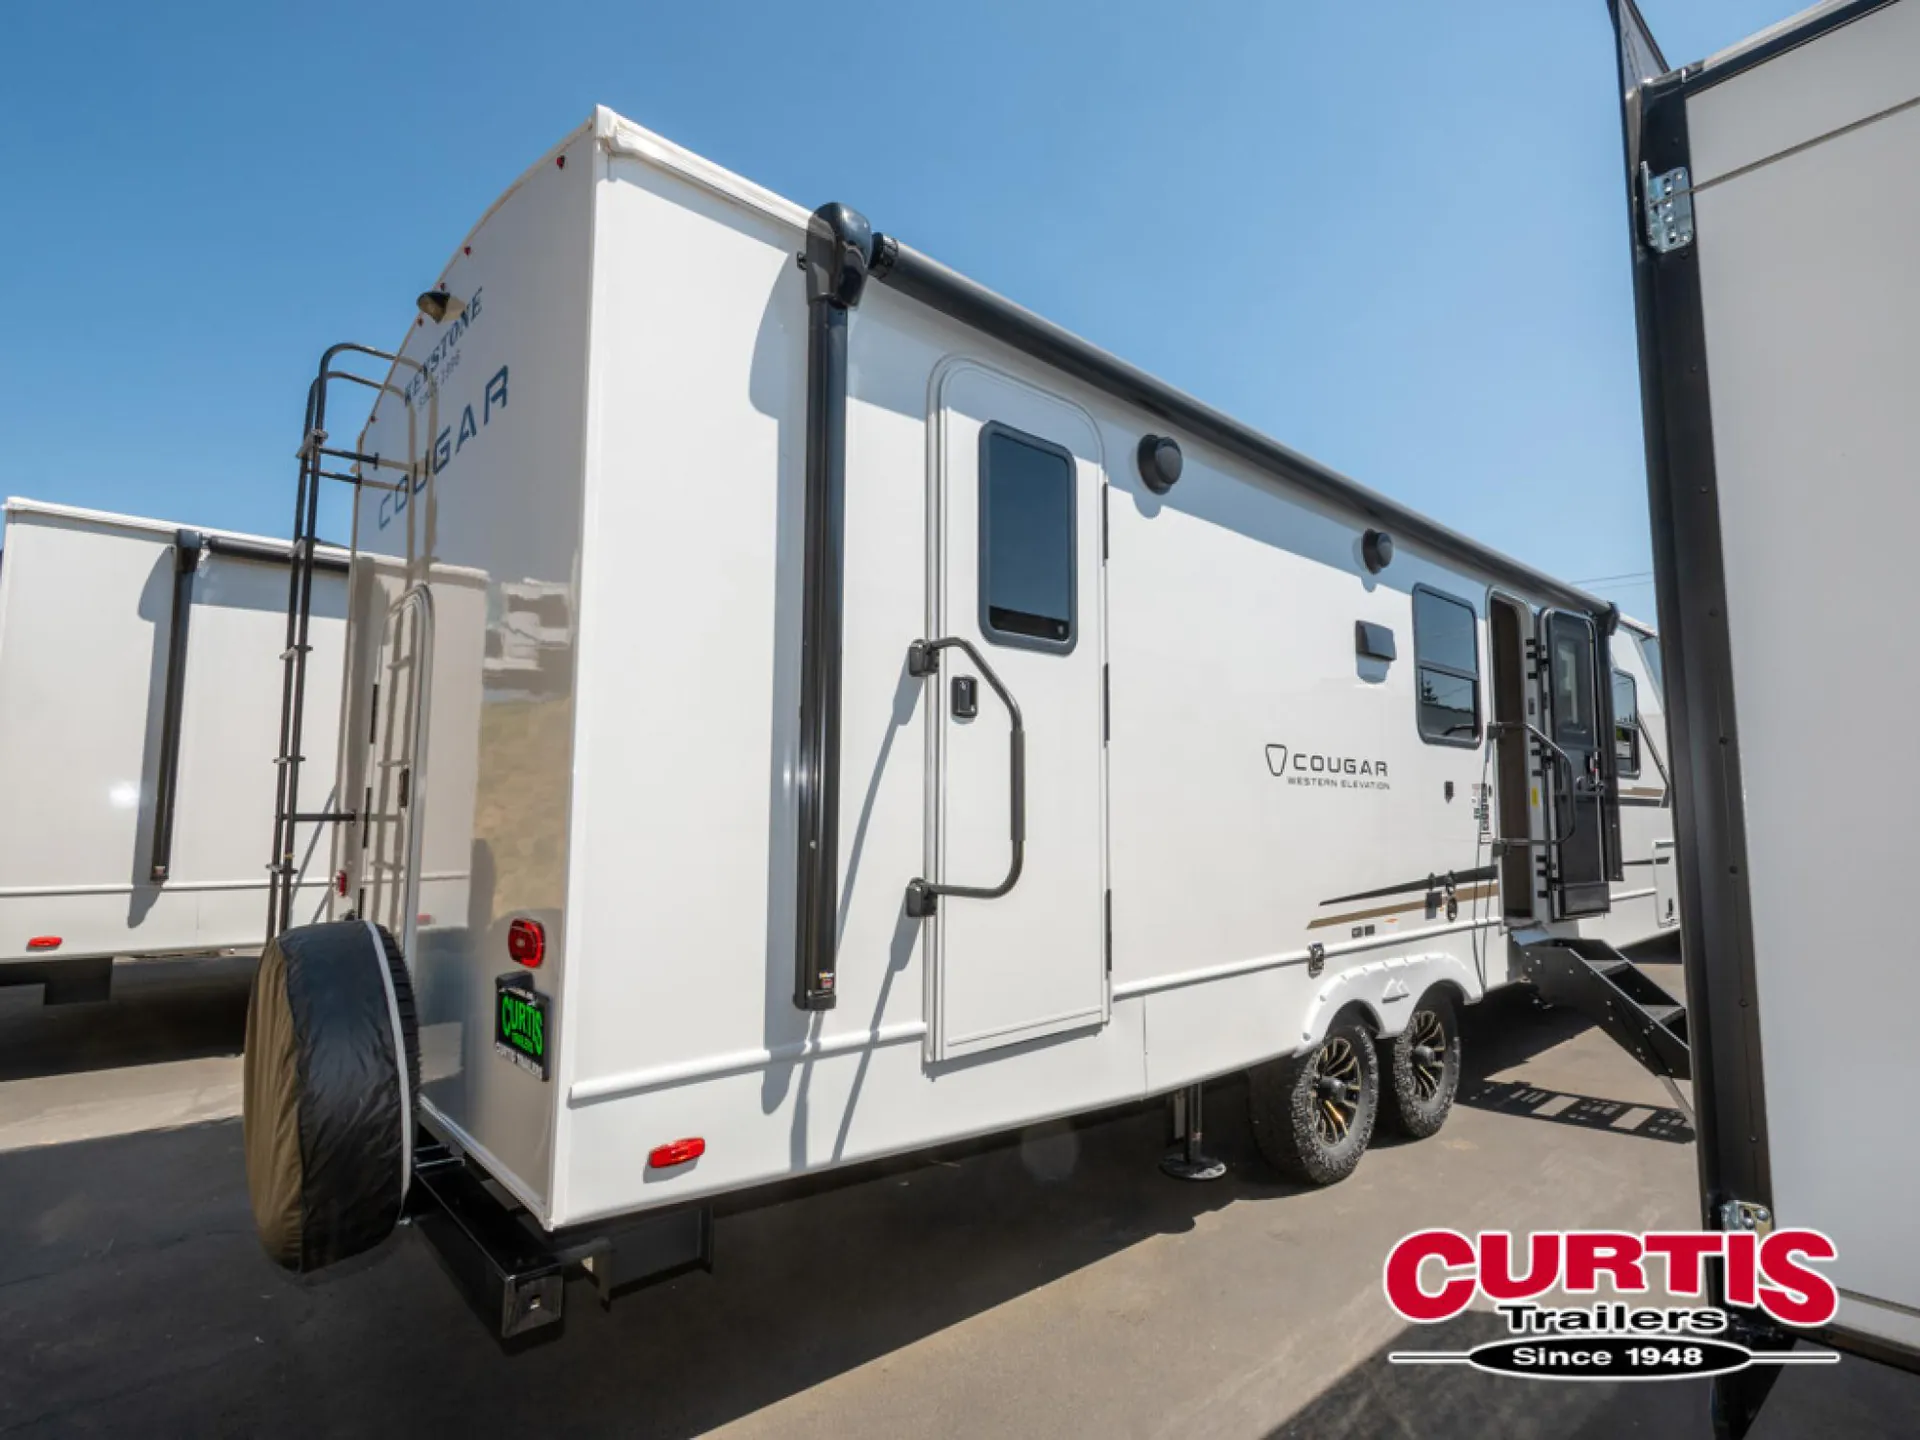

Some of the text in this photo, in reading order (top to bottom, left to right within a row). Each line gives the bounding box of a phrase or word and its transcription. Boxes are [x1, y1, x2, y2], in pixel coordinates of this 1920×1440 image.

[404, 286, 483, 407] KEYSTONE
[378, 365, 509, 531] COUGAR
[1288, 776, 1390, 790] WESTERN ELEVATION
[1293, 753, 1389, 777] COUGAR
[502, 995, 543, 1056] CURTIS
